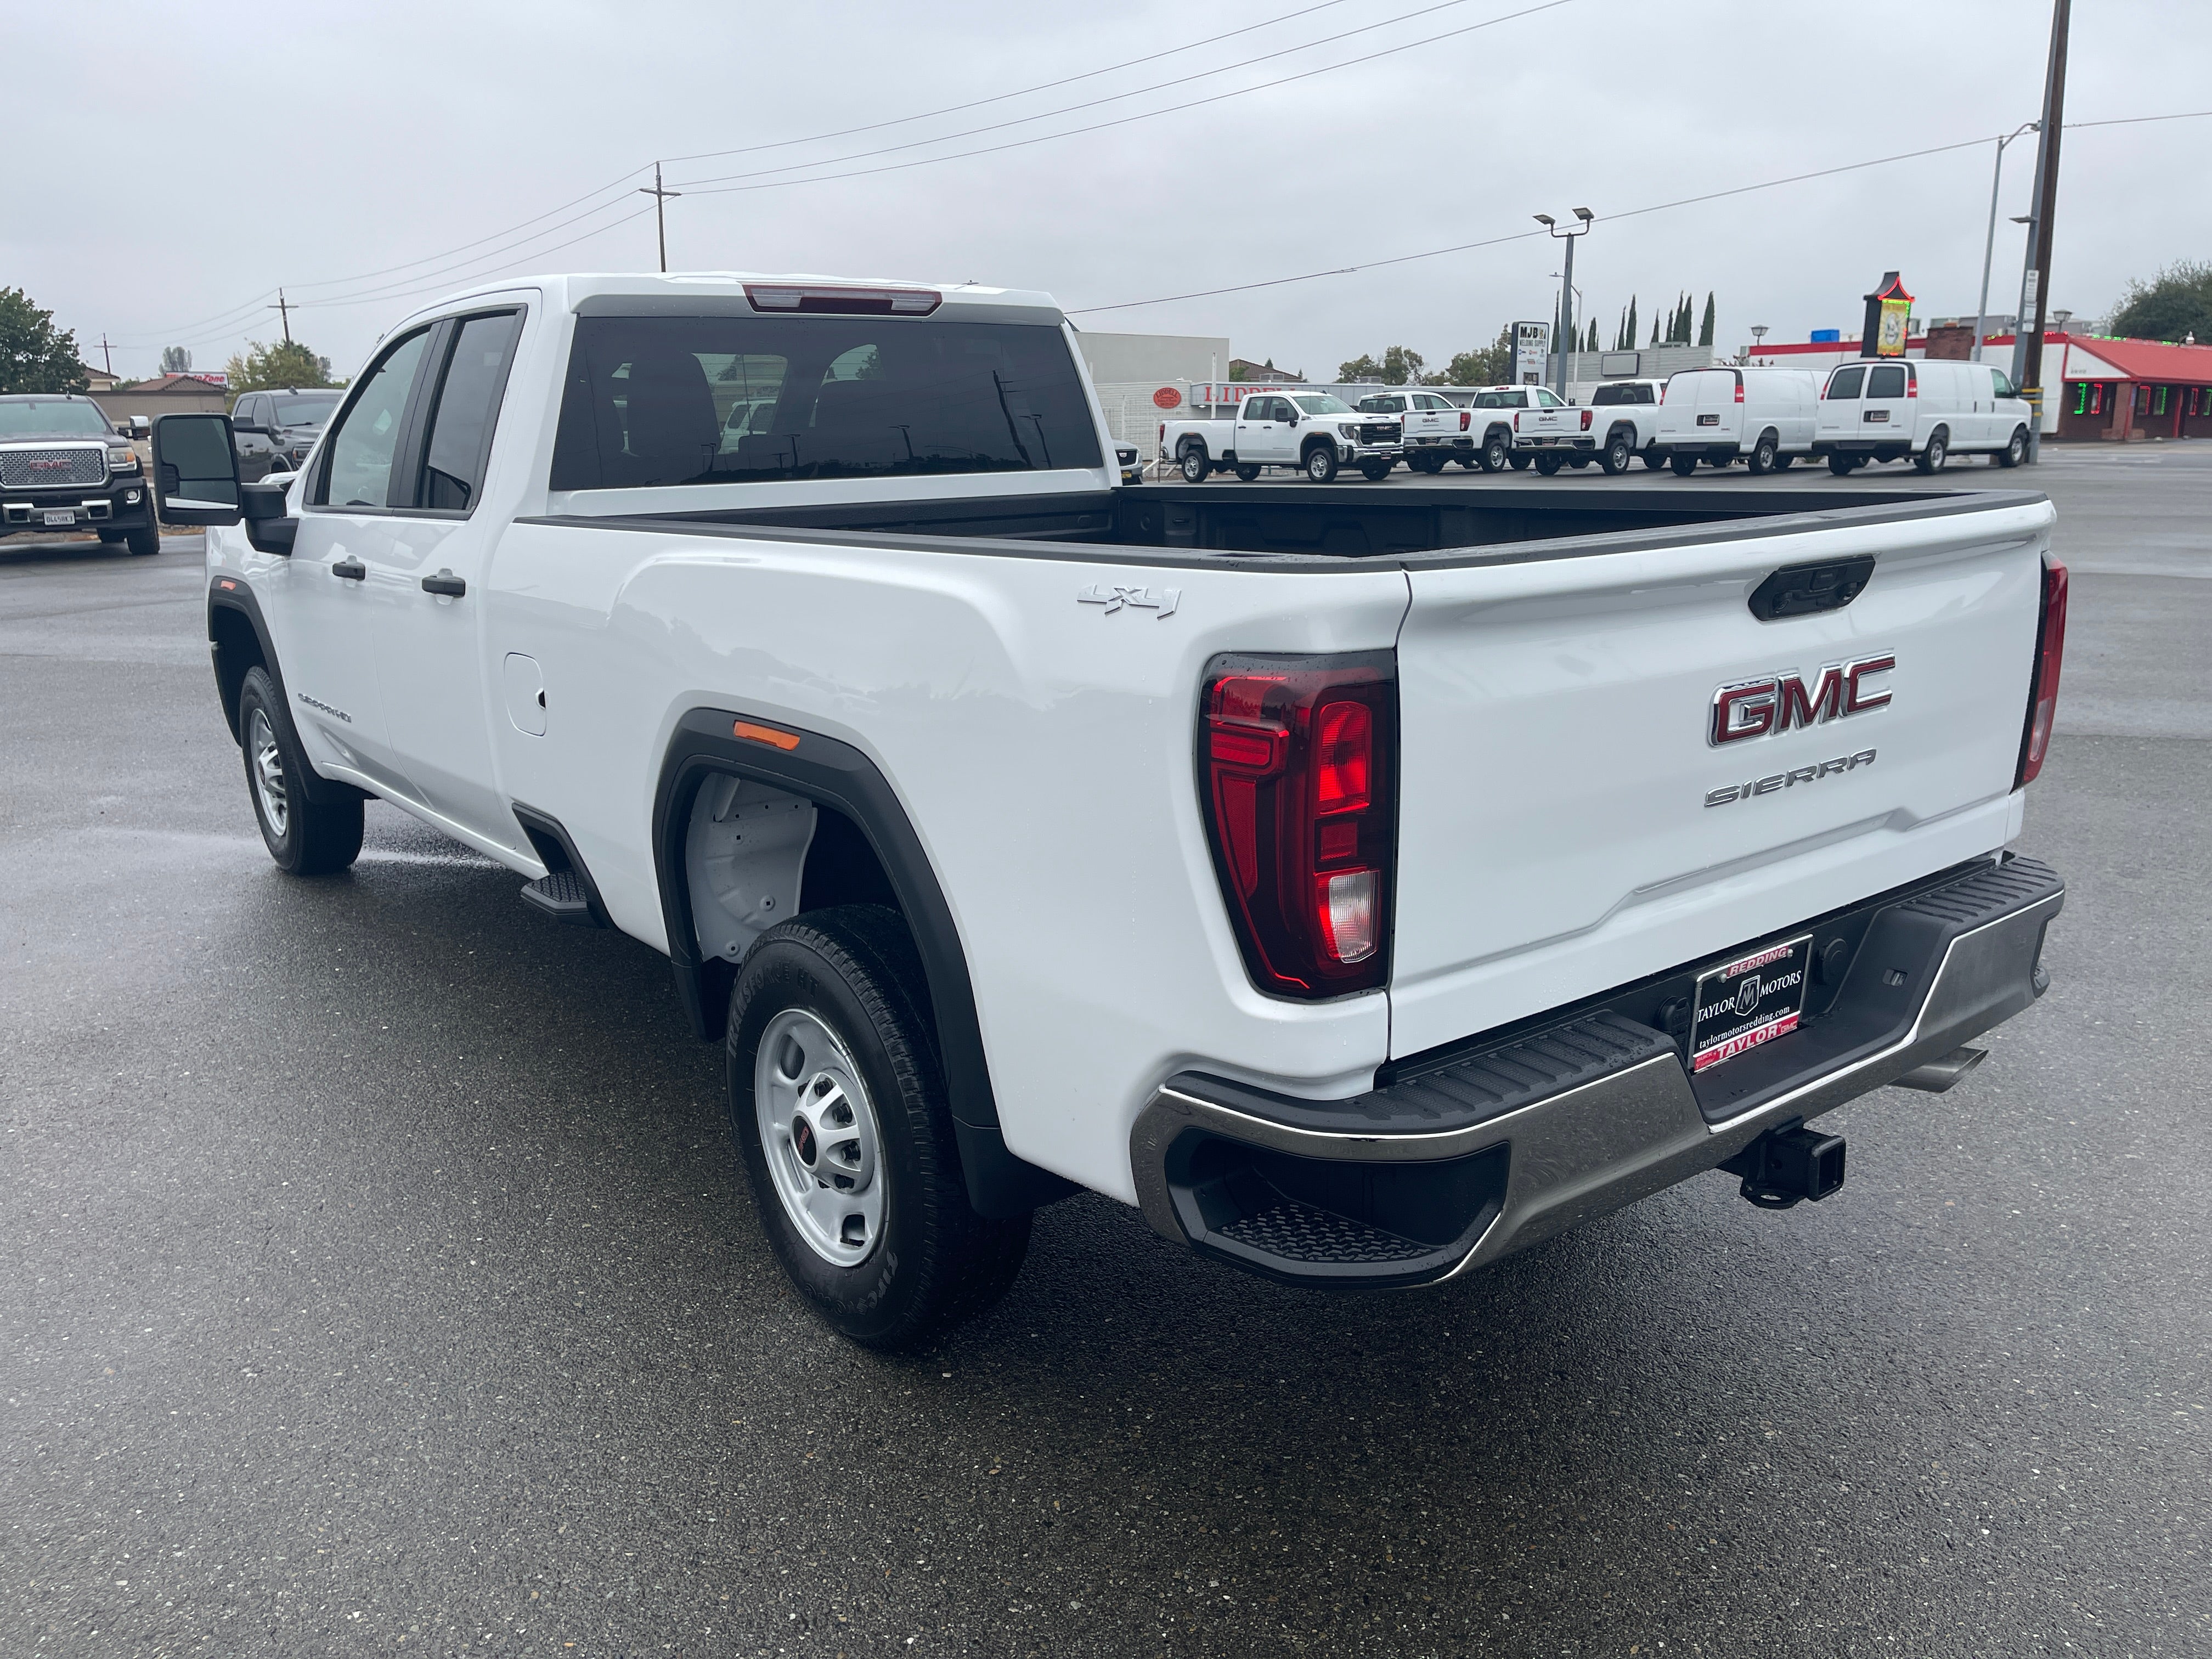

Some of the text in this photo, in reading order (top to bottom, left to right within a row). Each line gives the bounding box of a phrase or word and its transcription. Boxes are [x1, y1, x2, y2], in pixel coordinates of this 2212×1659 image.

[1520, 326, 1538, 338] MJB
[1707, 652, 1896, 748] GMC
[1704, 747, 1877, 808] SIERRA
[1729, 947, 1787, 976] REDDING
[1697, 996, 1736, 1023] TAYLOR
[1759, 970, 1802, 997] MOTORS
[1699, 1006, 1790, 1049] taylormotorsredding.com
[1717, 1024, 1779, 1059] TAYLOR
